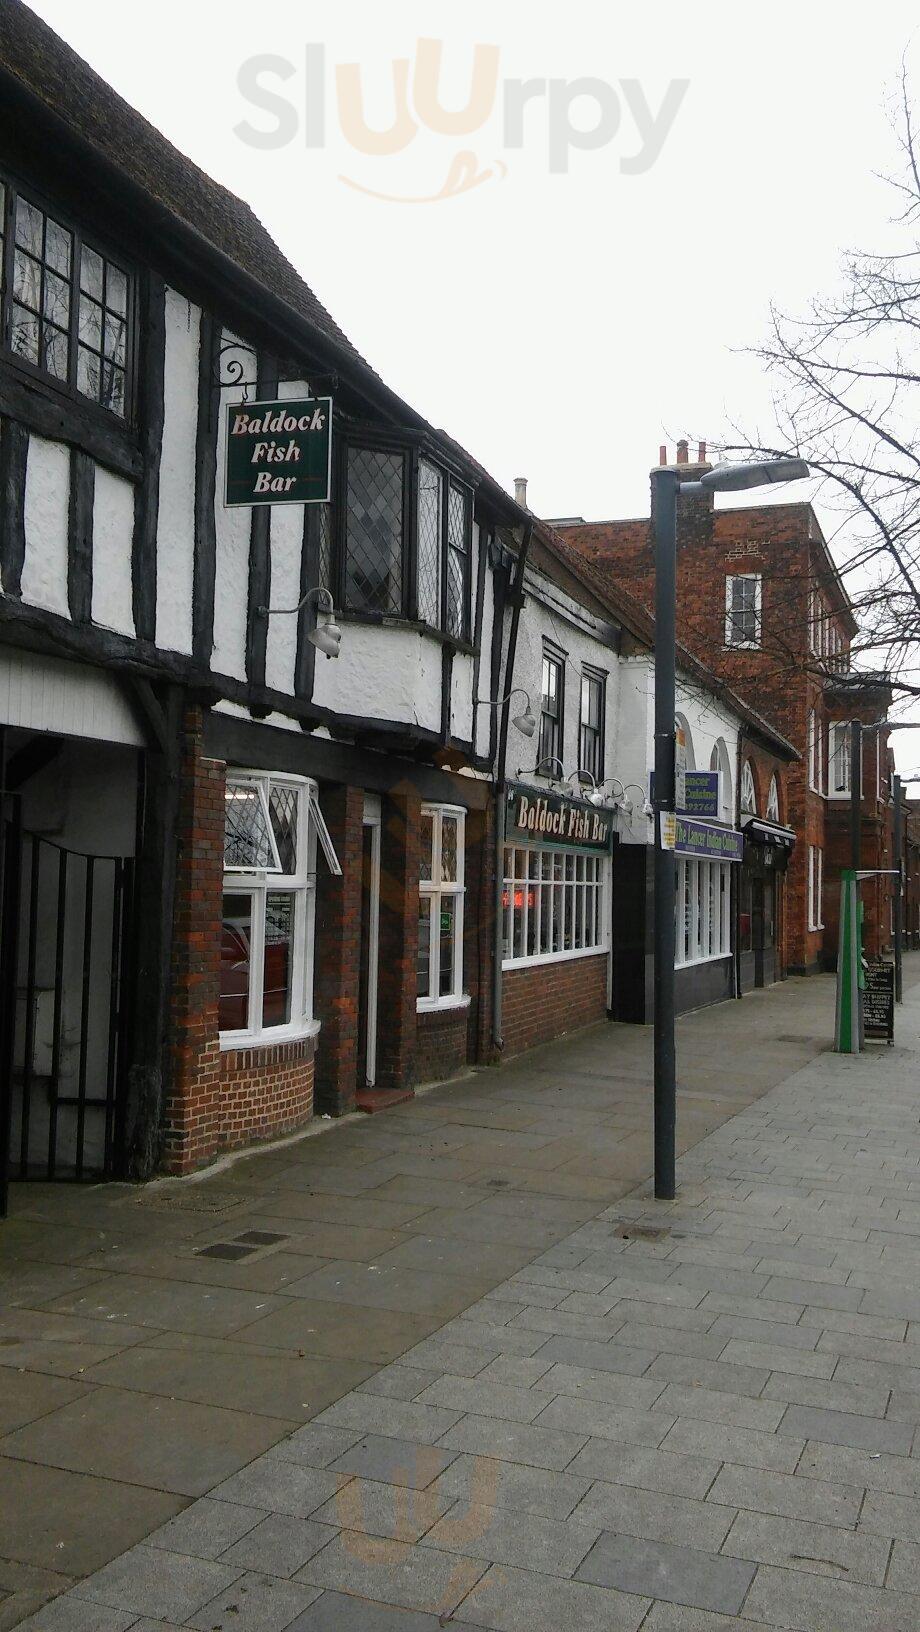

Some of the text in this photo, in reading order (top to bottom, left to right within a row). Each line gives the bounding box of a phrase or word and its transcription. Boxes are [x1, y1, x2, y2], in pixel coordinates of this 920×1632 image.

[231, 407, 326, 436] Baldock
[250, 439, 301, 464] Fish
[252, 471, 298, 494] Bar
[685, 777, 711, 787] ancer
[518, 795, 608, 842] Baldock Fish Bar
